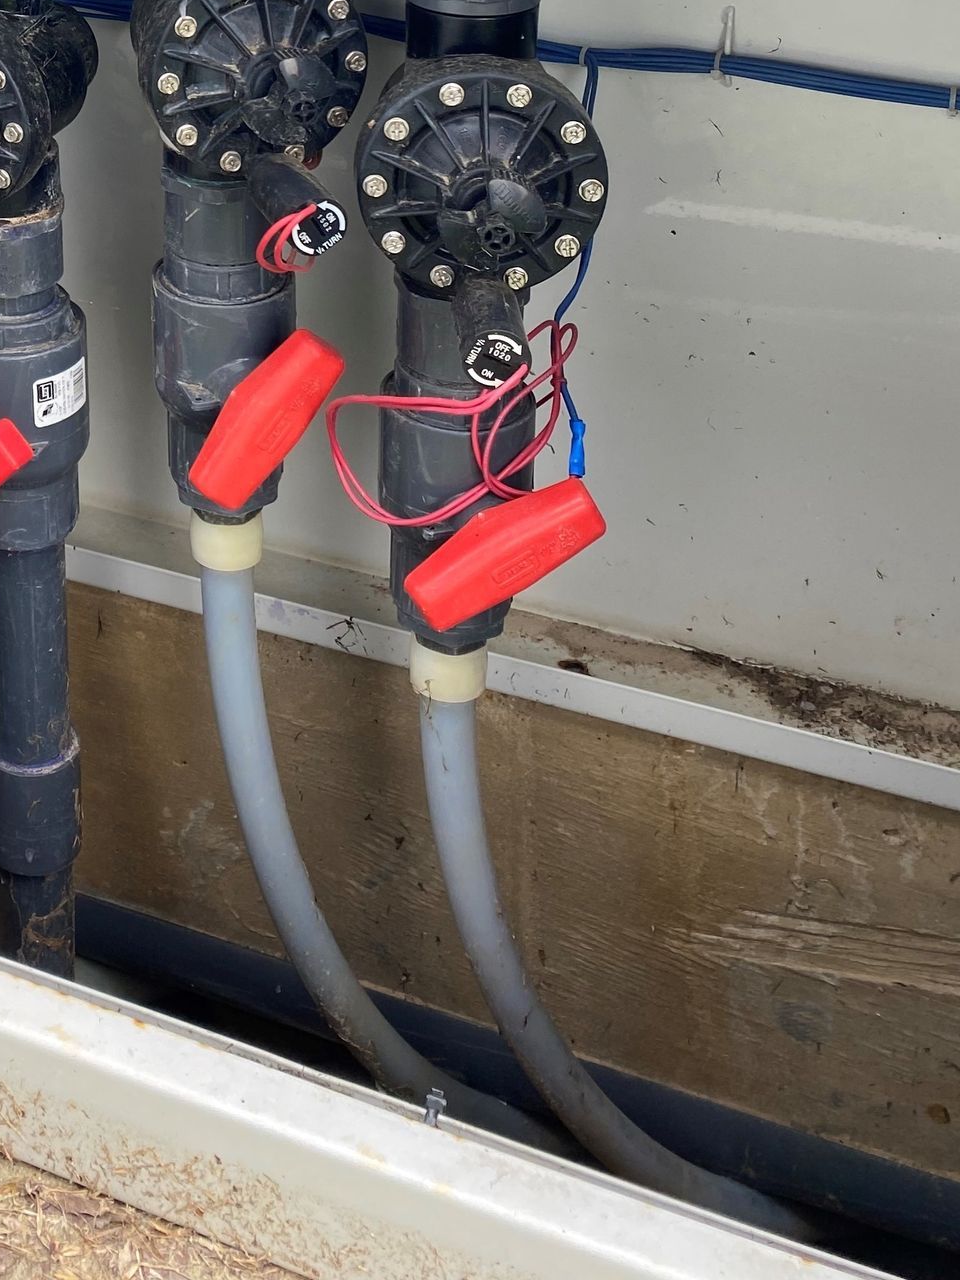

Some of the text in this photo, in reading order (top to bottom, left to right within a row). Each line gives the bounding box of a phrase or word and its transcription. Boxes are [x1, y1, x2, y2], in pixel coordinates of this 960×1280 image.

[325, 212, 337, 223] ON
[298, 231, 312, 244] OFF
[322, 232, 343, 250] TURN
[494, 342, 511, 353] OFF
[464, 346, 482, 365] TURN
[488, 347, 511, 362] 1020
[481, 368, 494, 379] ON
